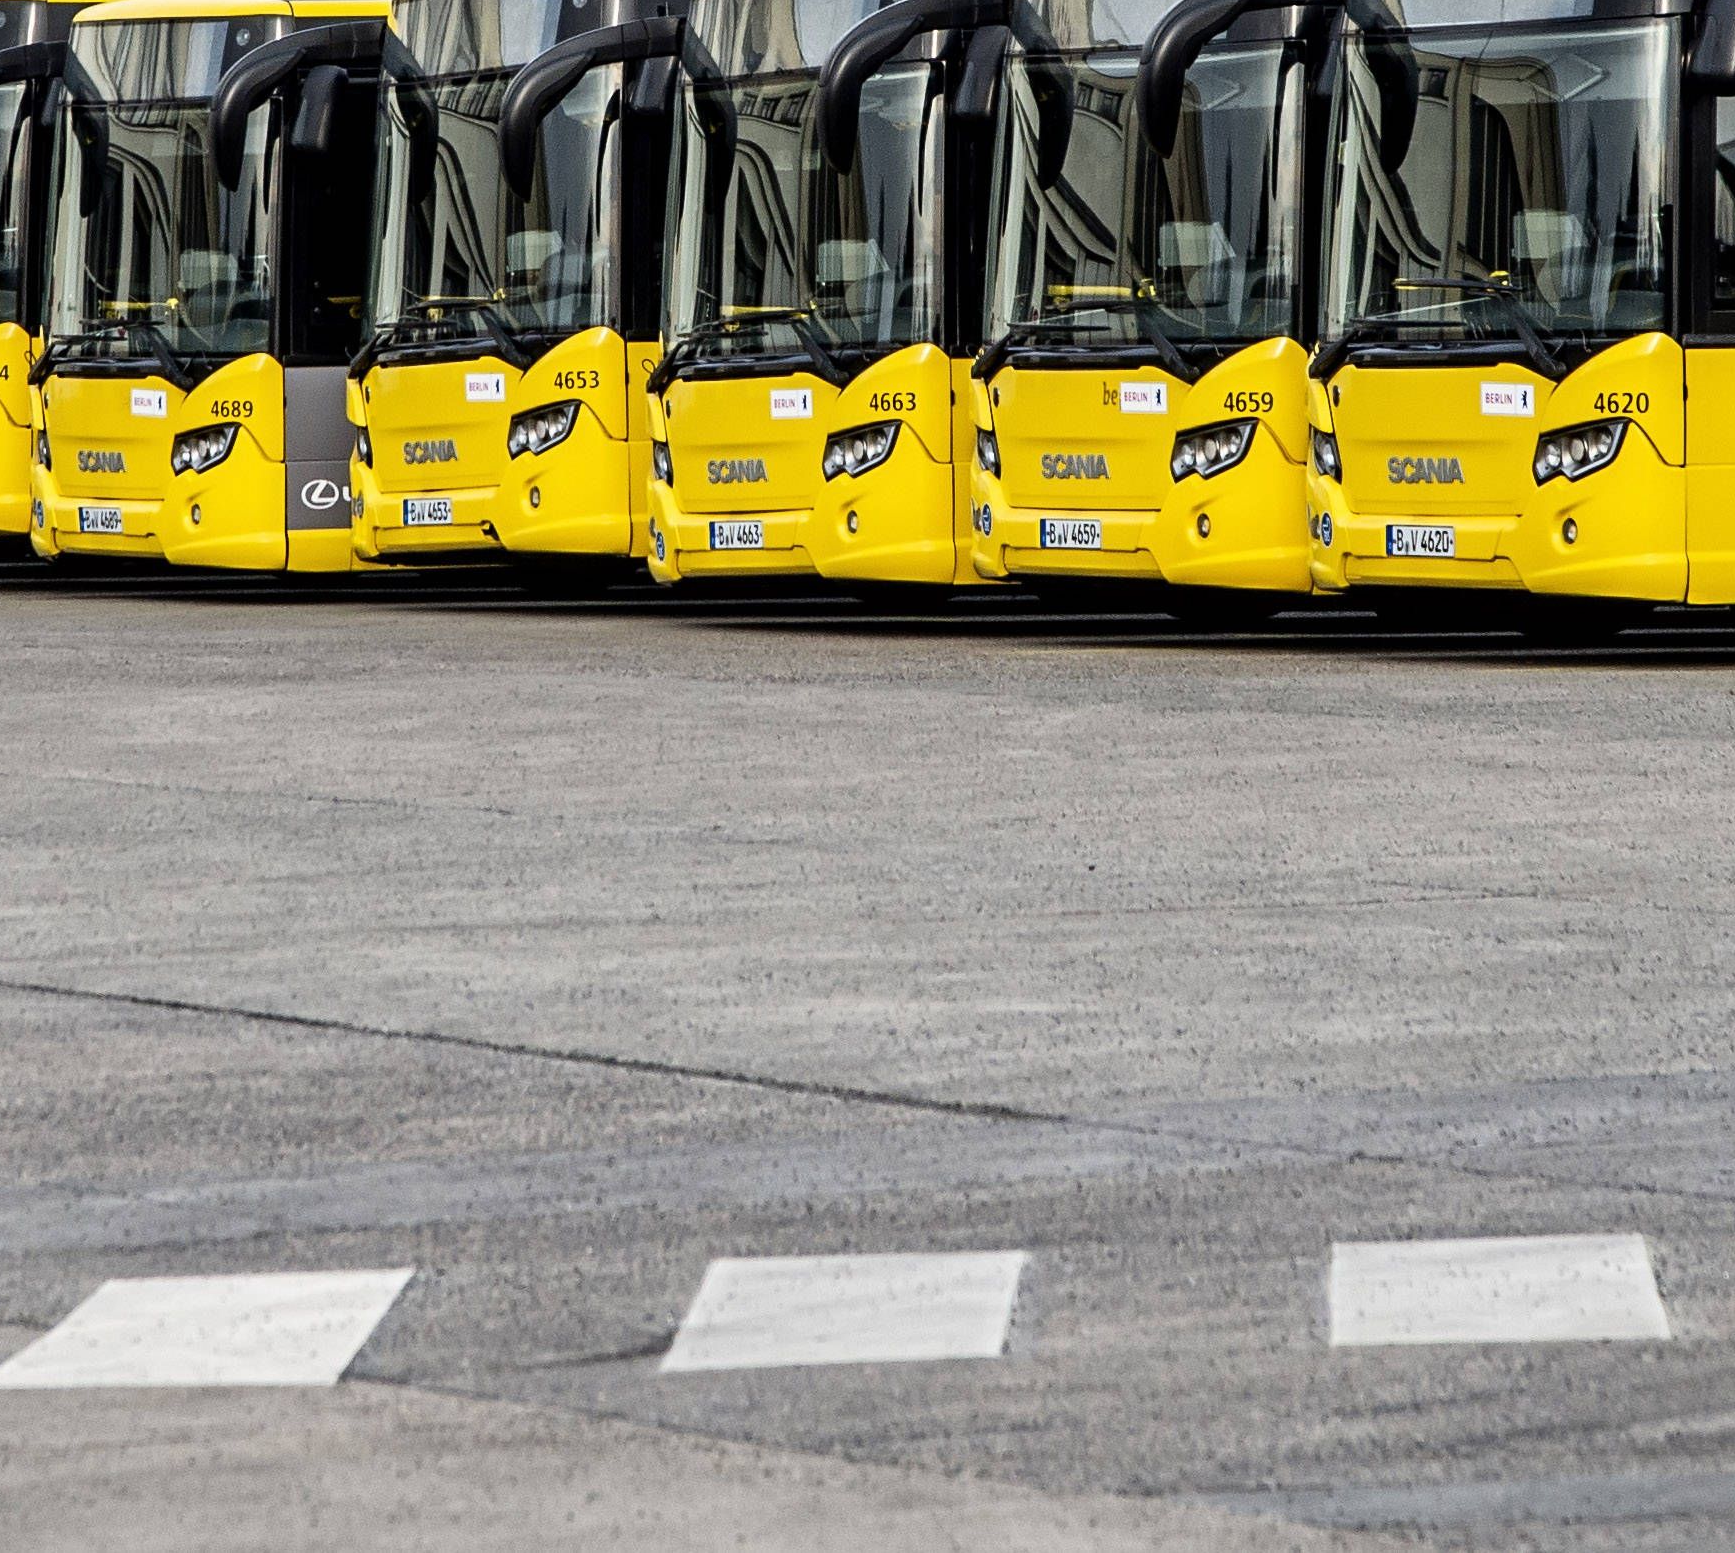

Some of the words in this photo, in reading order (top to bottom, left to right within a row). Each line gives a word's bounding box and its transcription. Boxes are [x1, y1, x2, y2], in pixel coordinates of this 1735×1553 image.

[468, 382, 489, 392] BERLIN
[553, 370, 600, 389] 4653
[773, 399, 796, 408] BERLIN
[869, 392, 917, 412] 4663
[1124, 392, 1148, 402] BERLIN
[1223, 391, 1274, 413] 4659
[1485, 392, 1513, 405] BERLIN
[1593, 392, 1650, 414] 4620
[211, 400, 254, 418] 4689
[77, 450, 126, 473] SCANIA
[403, 439, 458, 464] SCANIA
[707, 458, 769, 484] SCANIA
[1041, 453, 1110, 480] SCANIA
[1388, 456, 1465, 484] SCANIA
[427, 502, 448, 521] 4653
[737, 525, 760, 545] 4663
[1071, 525, 1097, 545] 4659
[1421, 529, 1449, 553] 4620
